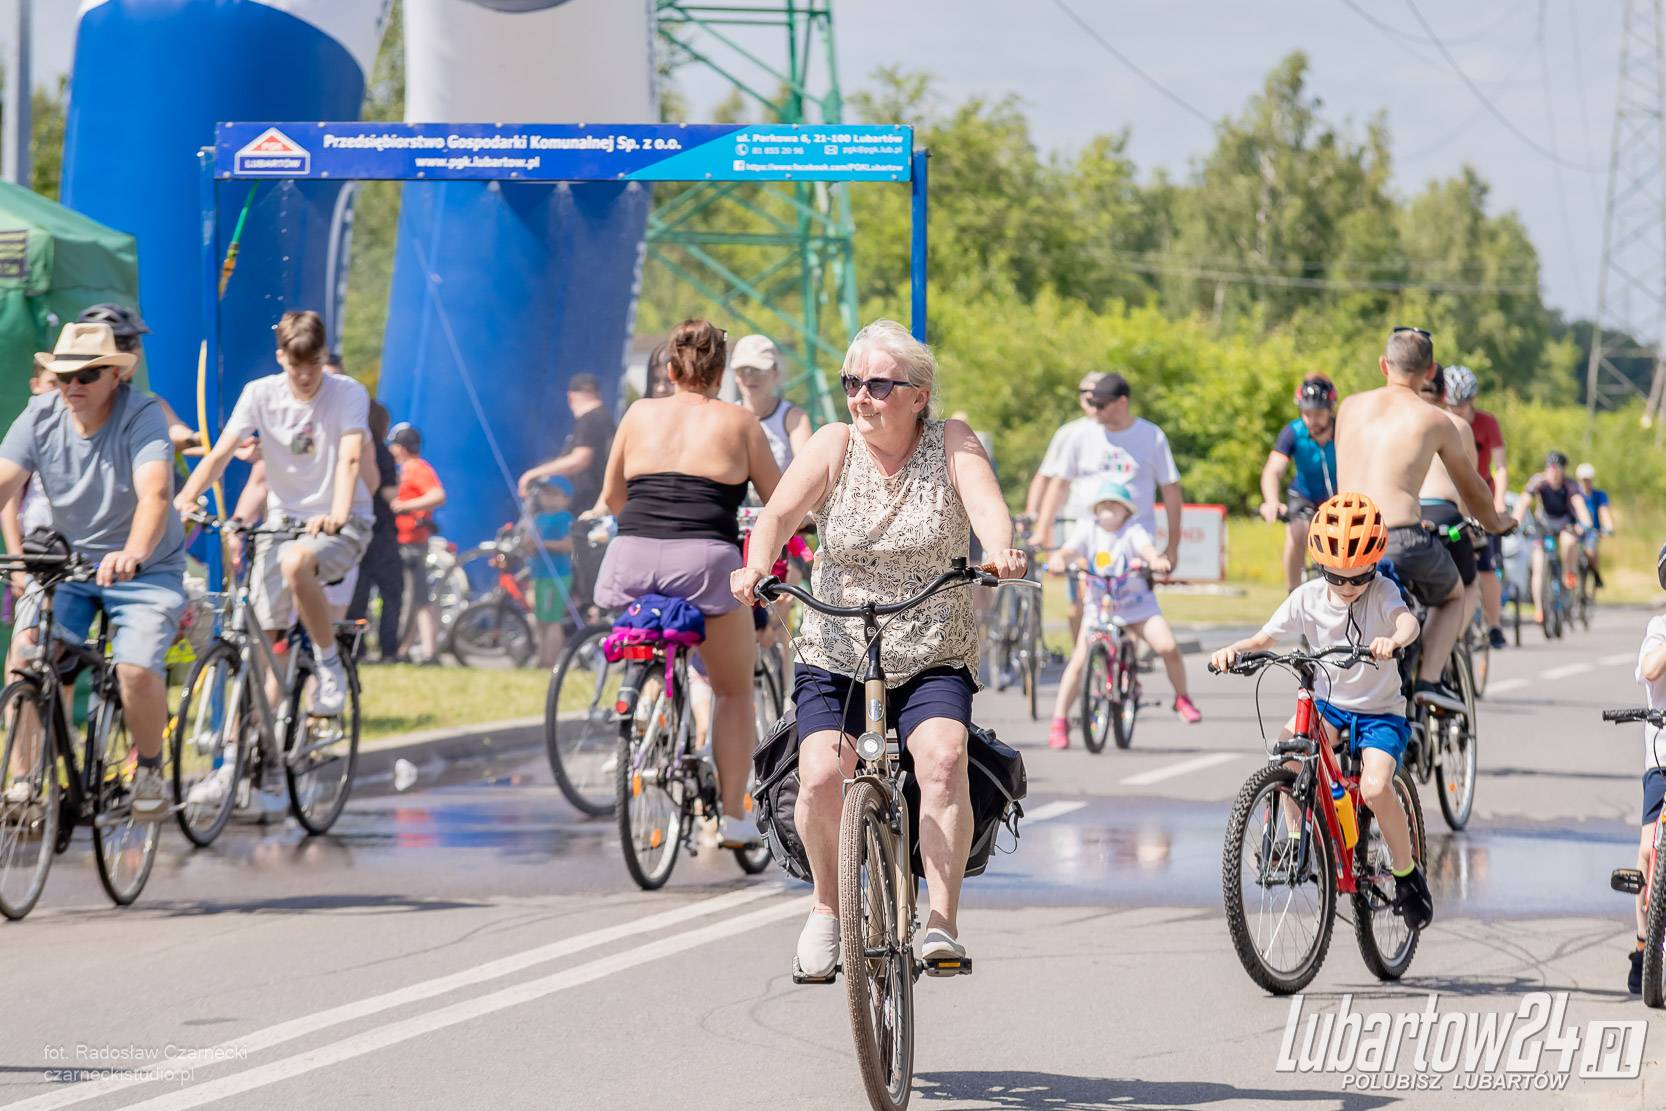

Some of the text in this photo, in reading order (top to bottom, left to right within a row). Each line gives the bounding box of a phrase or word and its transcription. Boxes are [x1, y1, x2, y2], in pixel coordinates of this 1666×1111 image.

[323, 134, 682, 152] Przedsiębiorstwo Gospodarki Komunalnej Sp. z o.o.
[752, 134, 799, 143] Parkowa
[853, 134, 904, 143] Lubartów
[415, 156, 541, 170] www.pgk.lubartow.pl
